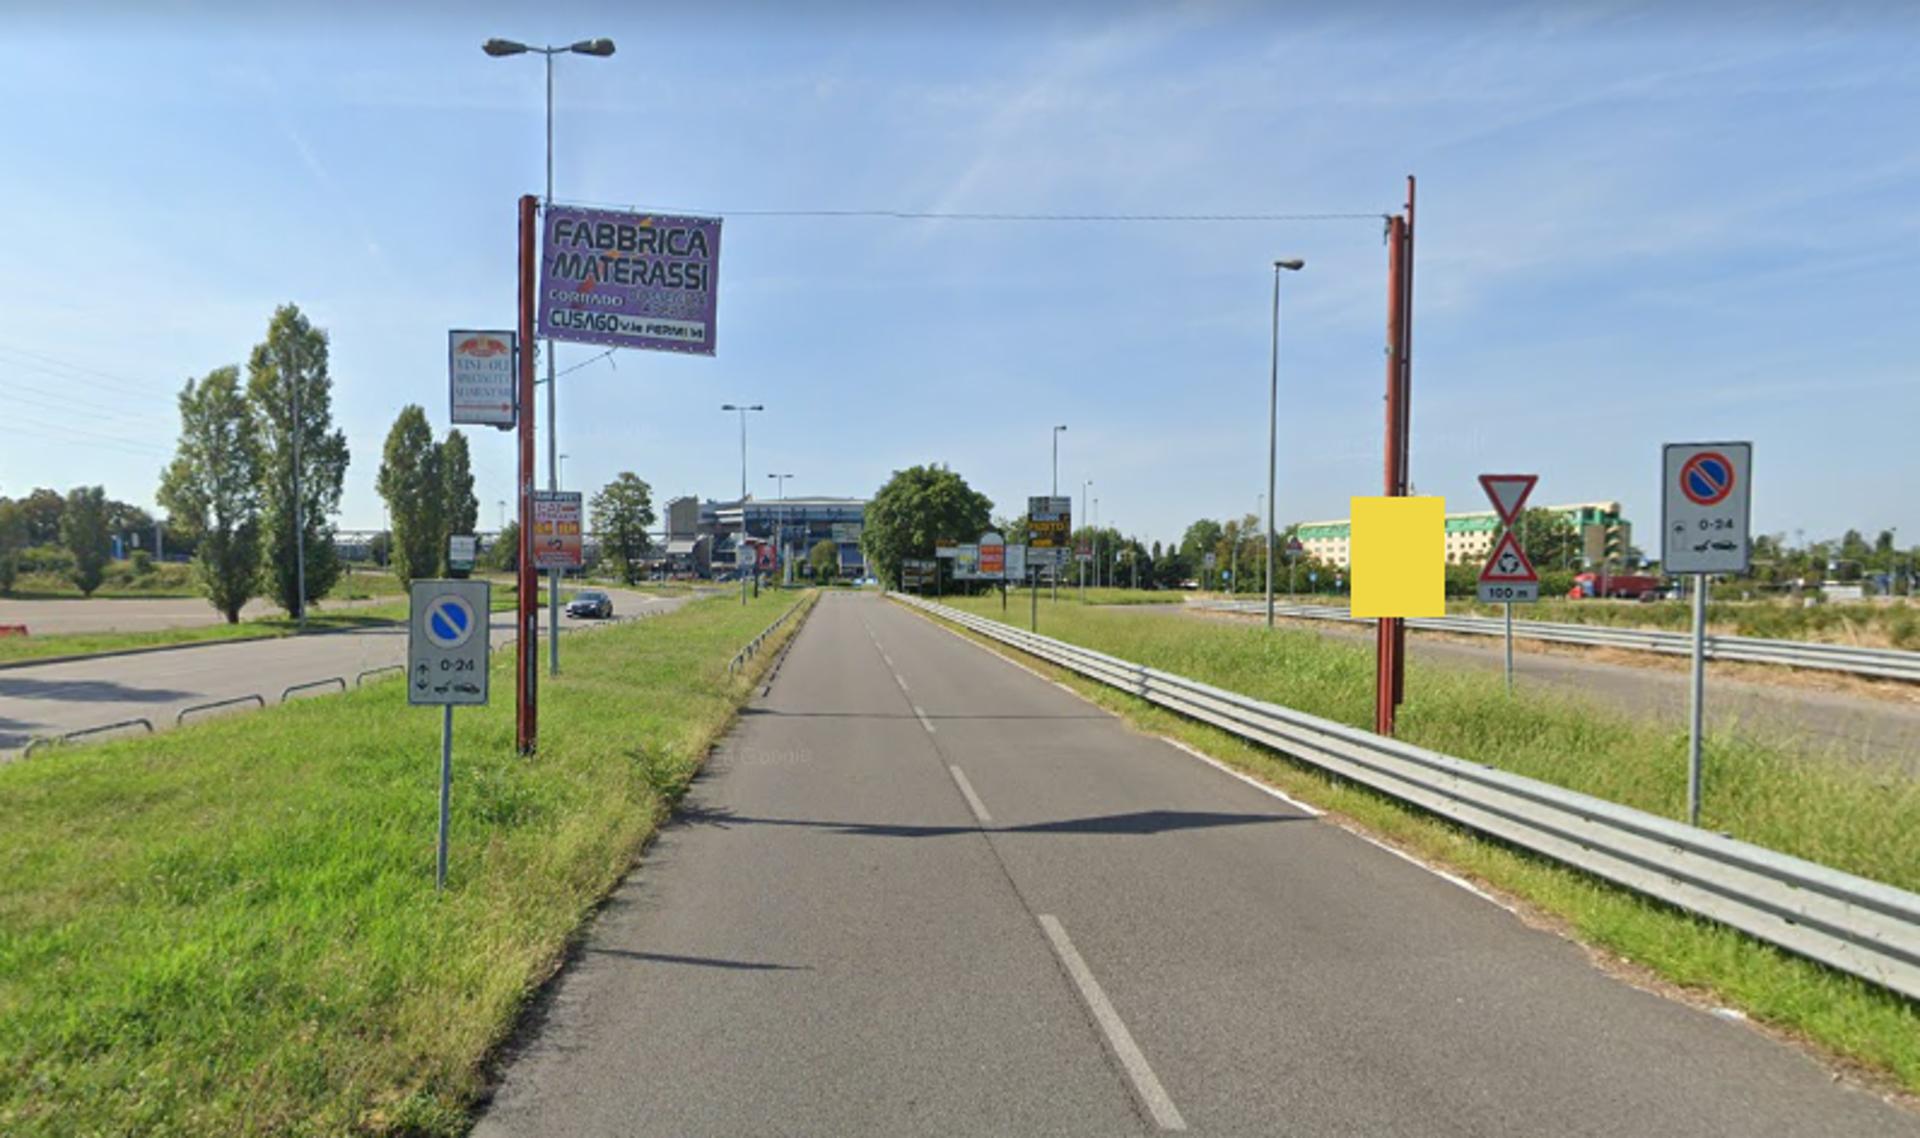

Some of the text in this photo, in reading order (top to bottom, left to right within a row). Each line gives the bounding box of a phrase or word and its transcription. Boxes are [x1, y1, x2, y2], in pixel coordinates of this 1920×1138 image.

[552, 218, 710, 259] FABBRICA
[551, 252, 709, 293] MATERASSI
[550, 310, 619, 332] CUSAGO
[1699, 518, 1734, 531] 0-24
[1489, 587, 1529, 599] 100 m
[440, 659, 475, 672] 0-24
